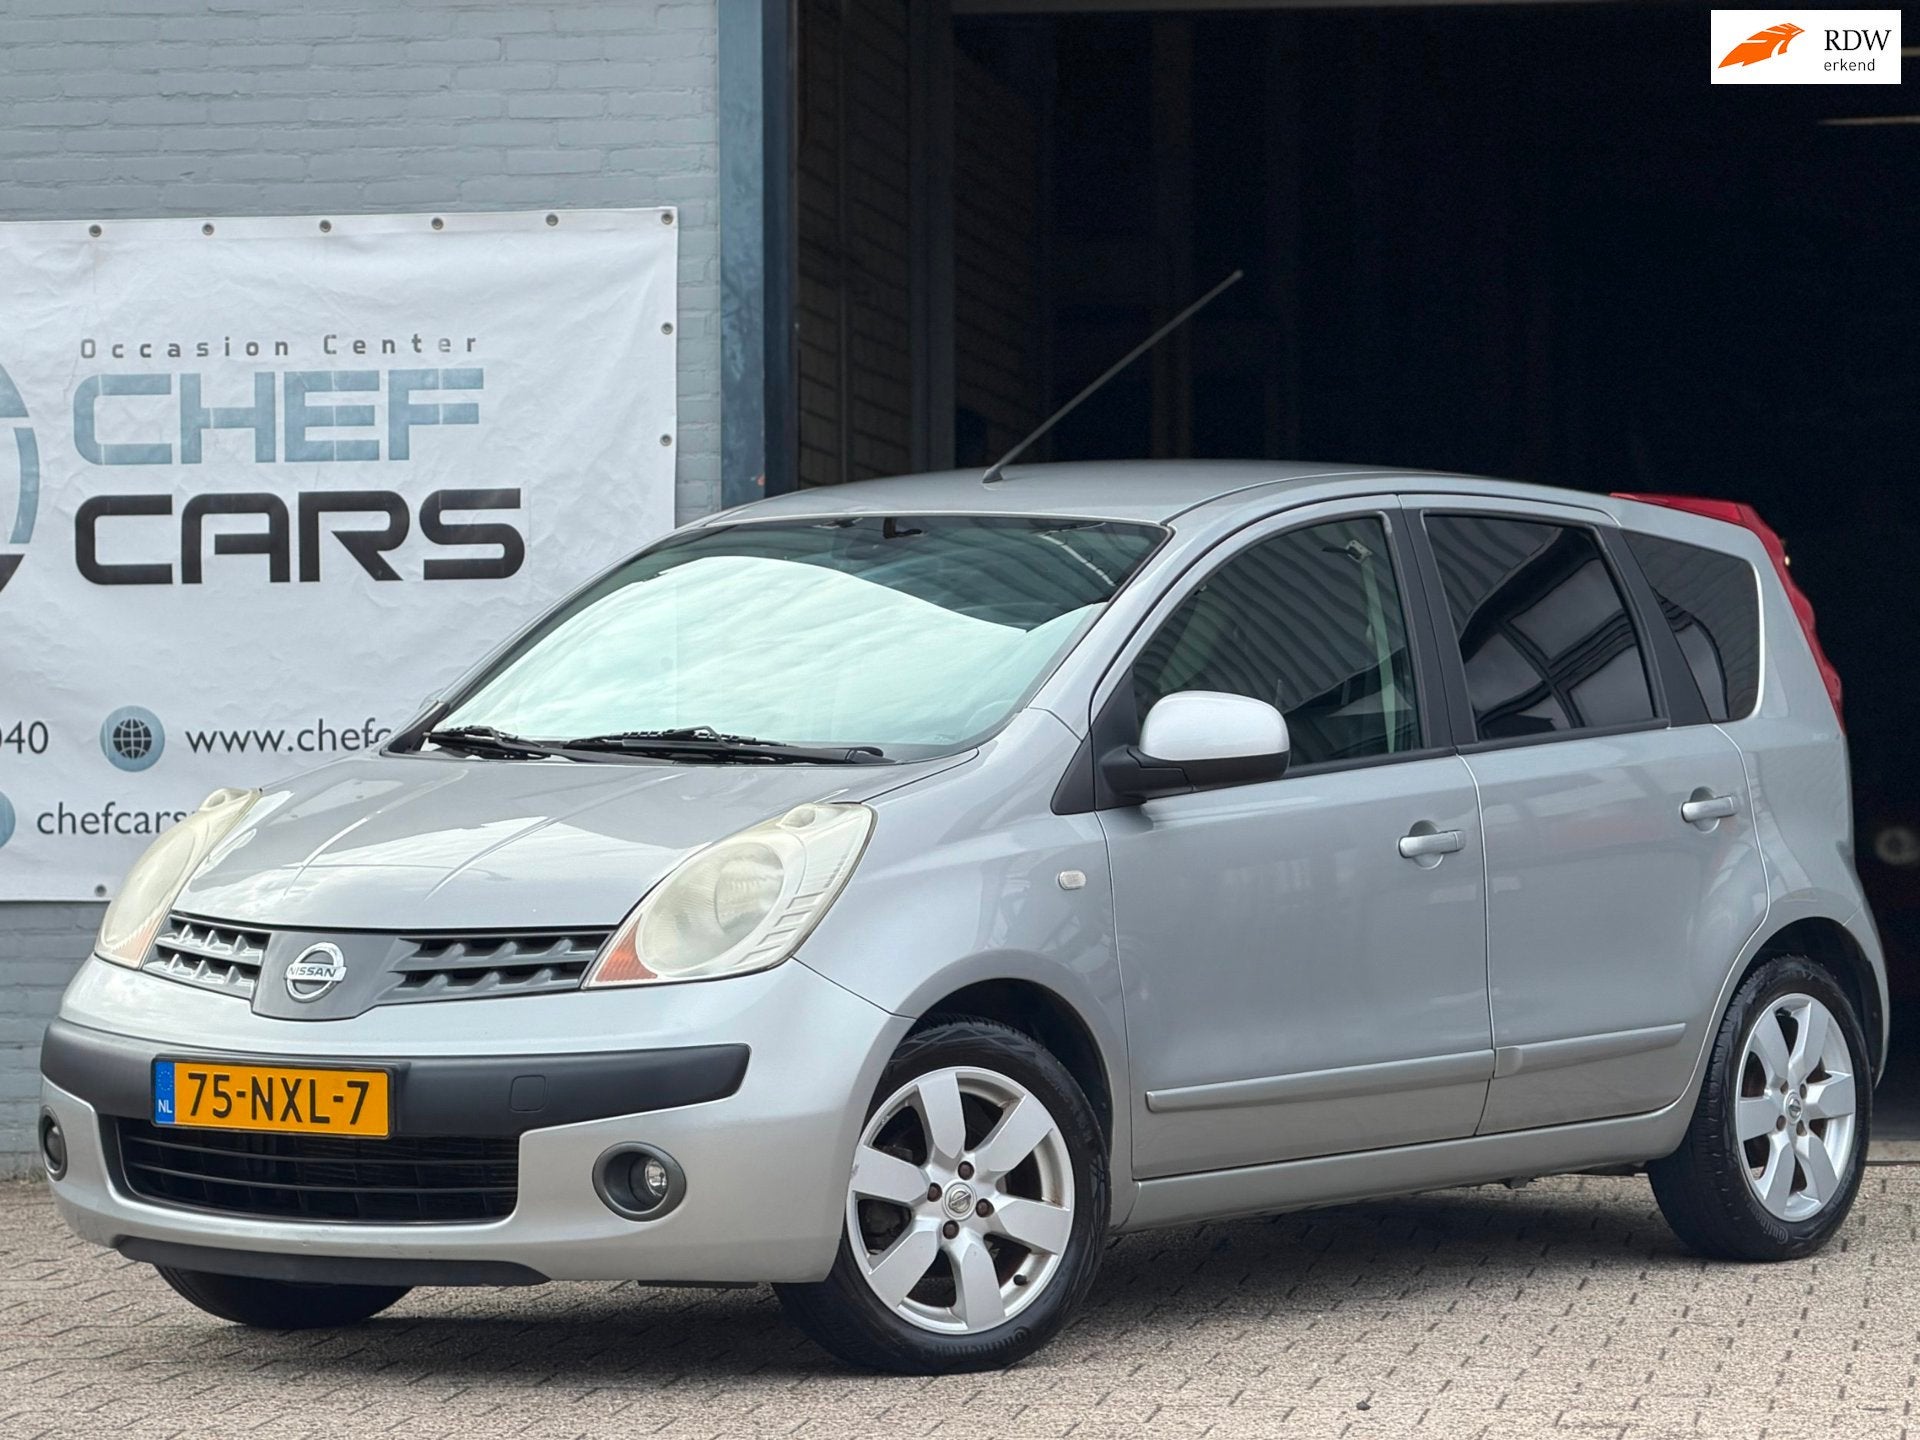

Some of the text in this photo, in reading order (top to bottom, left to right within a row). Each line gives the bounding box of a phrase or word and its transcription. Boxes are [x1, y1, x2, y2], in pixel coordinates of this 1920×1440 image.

[80, 333, 476, 359] Occasion Center
[73, 367, 484, 466] CHEF
[75, 488, 525, 585] CARS
[0, 720, 49, 754] 40
[36, 801, 195, 835] chefcars
[288, 966, 337, 978] NISSAN
[158, 1100, 173, 1114] NL
[188, 1072, 370, 1125] 75-NXL-7
